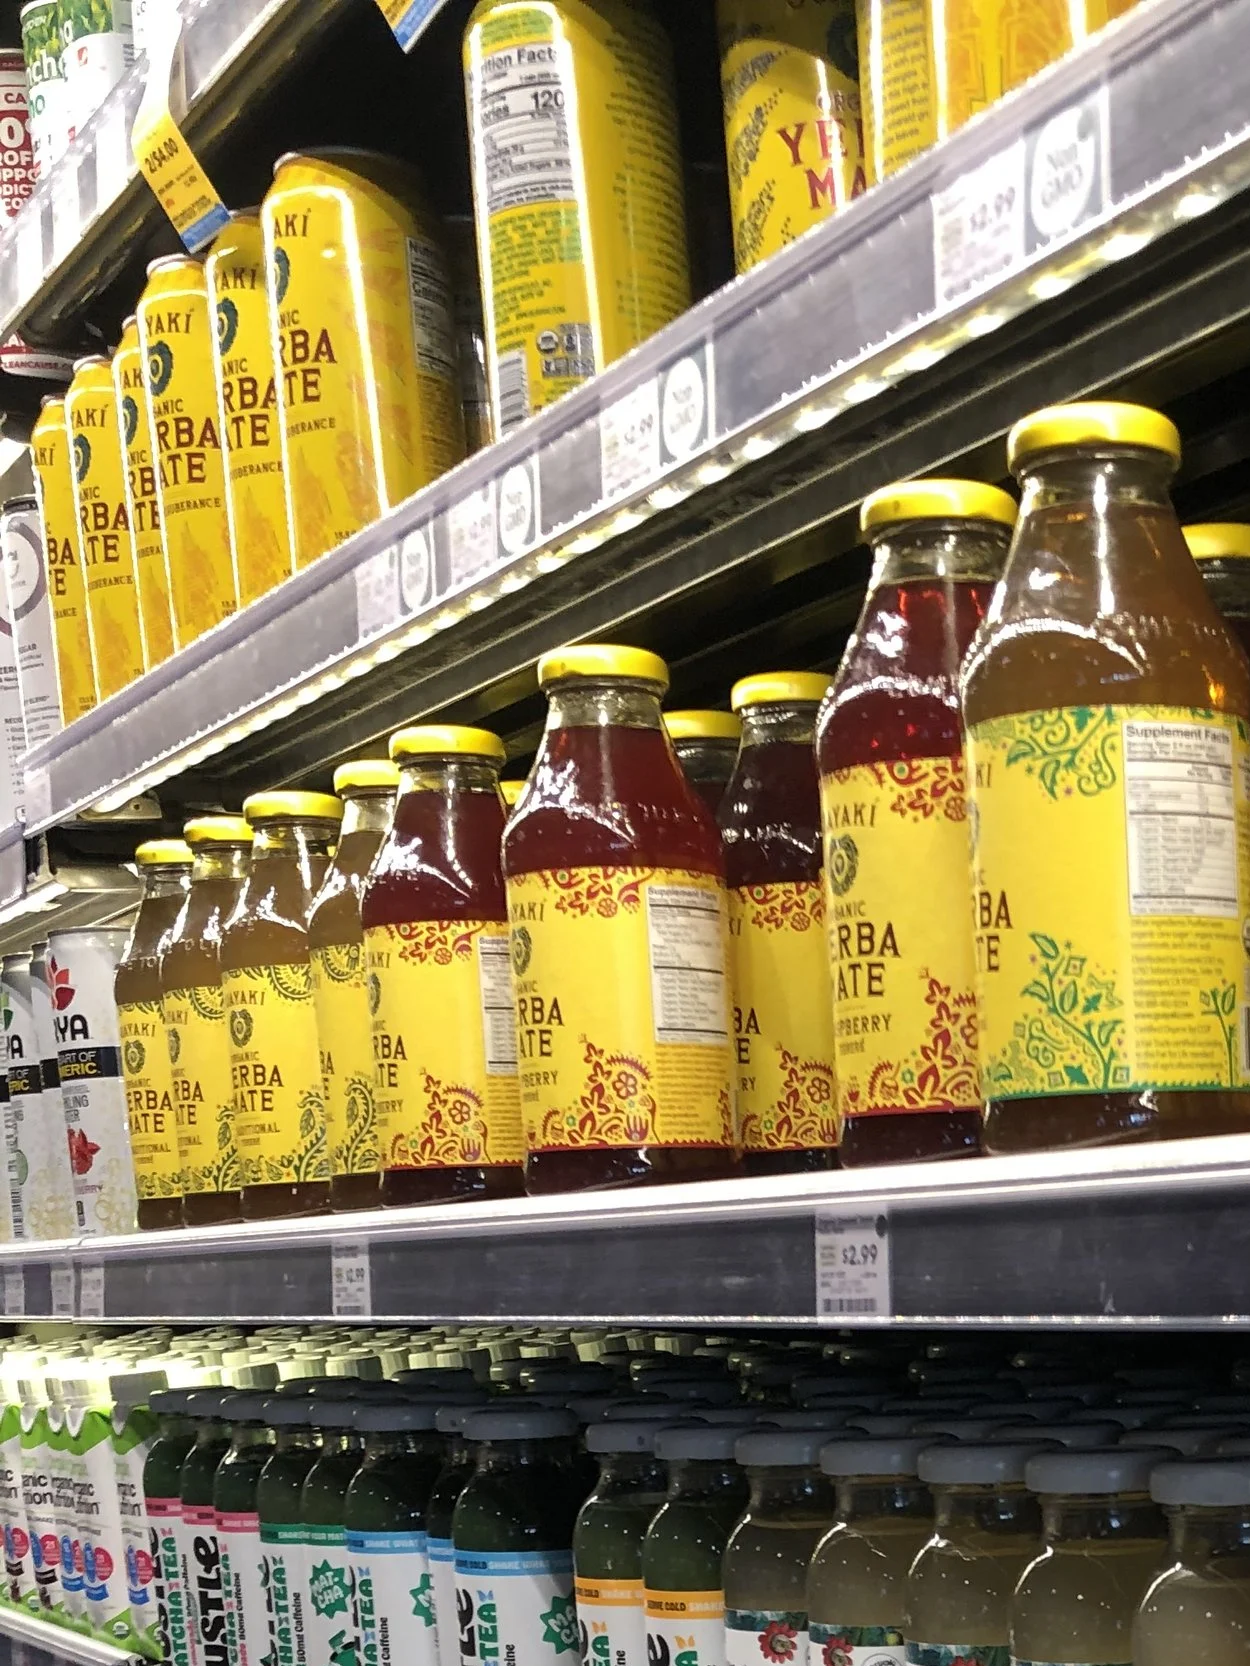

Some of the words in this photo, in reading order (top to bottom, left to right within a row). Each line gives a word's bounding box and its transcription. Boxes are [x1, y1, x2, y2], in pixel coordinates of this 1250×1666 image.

[1126, 725, 1200, 741] Supplement
[841, 1243, 879, 1267] $2.99
[162, 1537, 180, 1581] TEA
[272, 1566, 289, 1617] TEA
[358, 1578, 375, 1631] TEA
[380, 1617, 391, 1660] Caffeine
[477, 1603, 500, 1661] TEA
